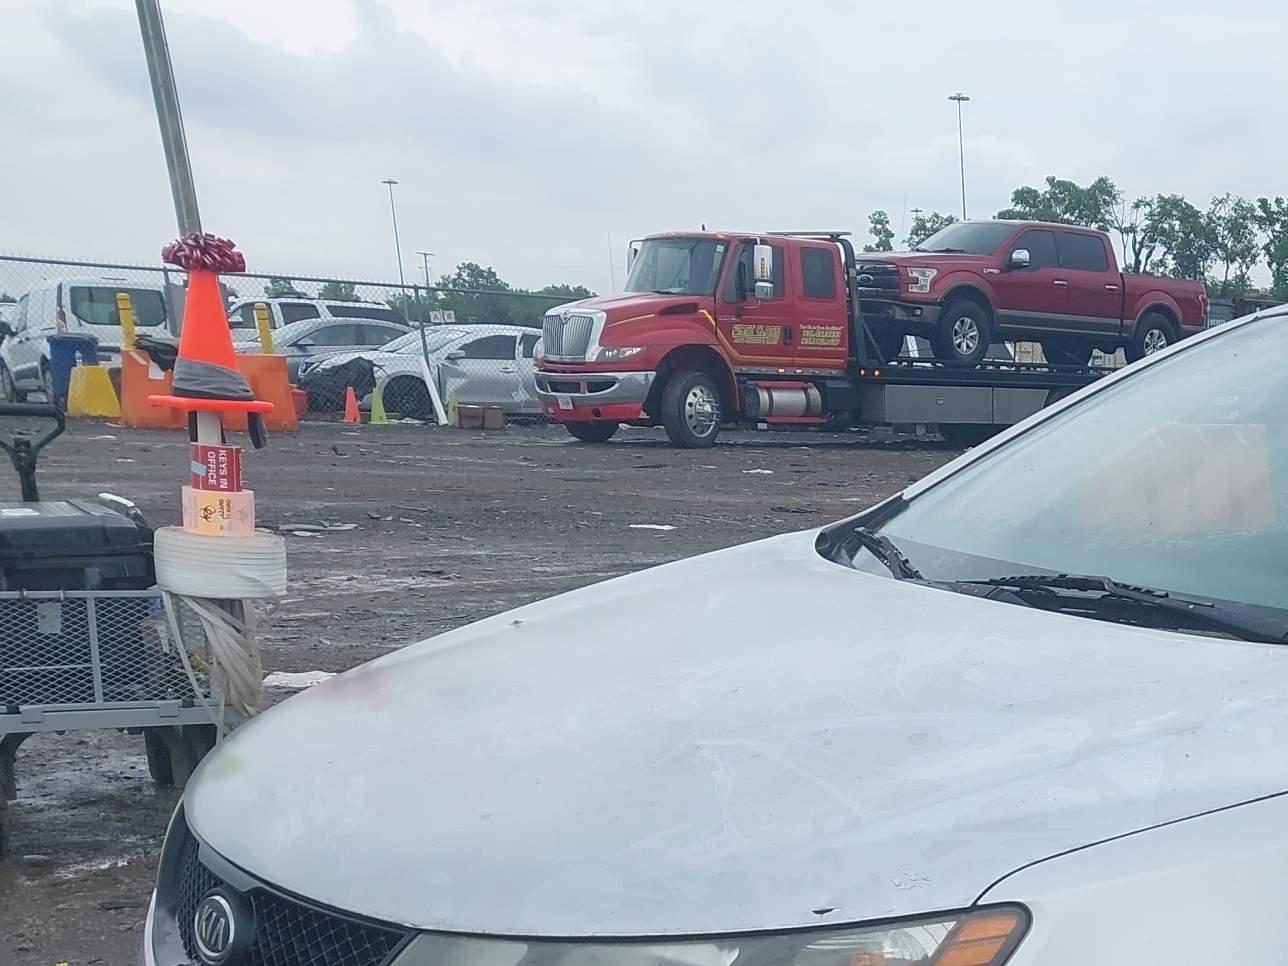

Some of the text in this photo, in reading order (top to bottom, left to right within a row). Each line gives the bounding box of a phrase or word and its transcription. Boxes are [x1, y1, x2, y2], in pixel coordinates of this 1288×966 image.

[208, 451, 216, 485] OFFICE
[219, 449, 227, 475] KEYS
[219, 478, 228, 489] IN
[198, 905, 225, 951] KIA
